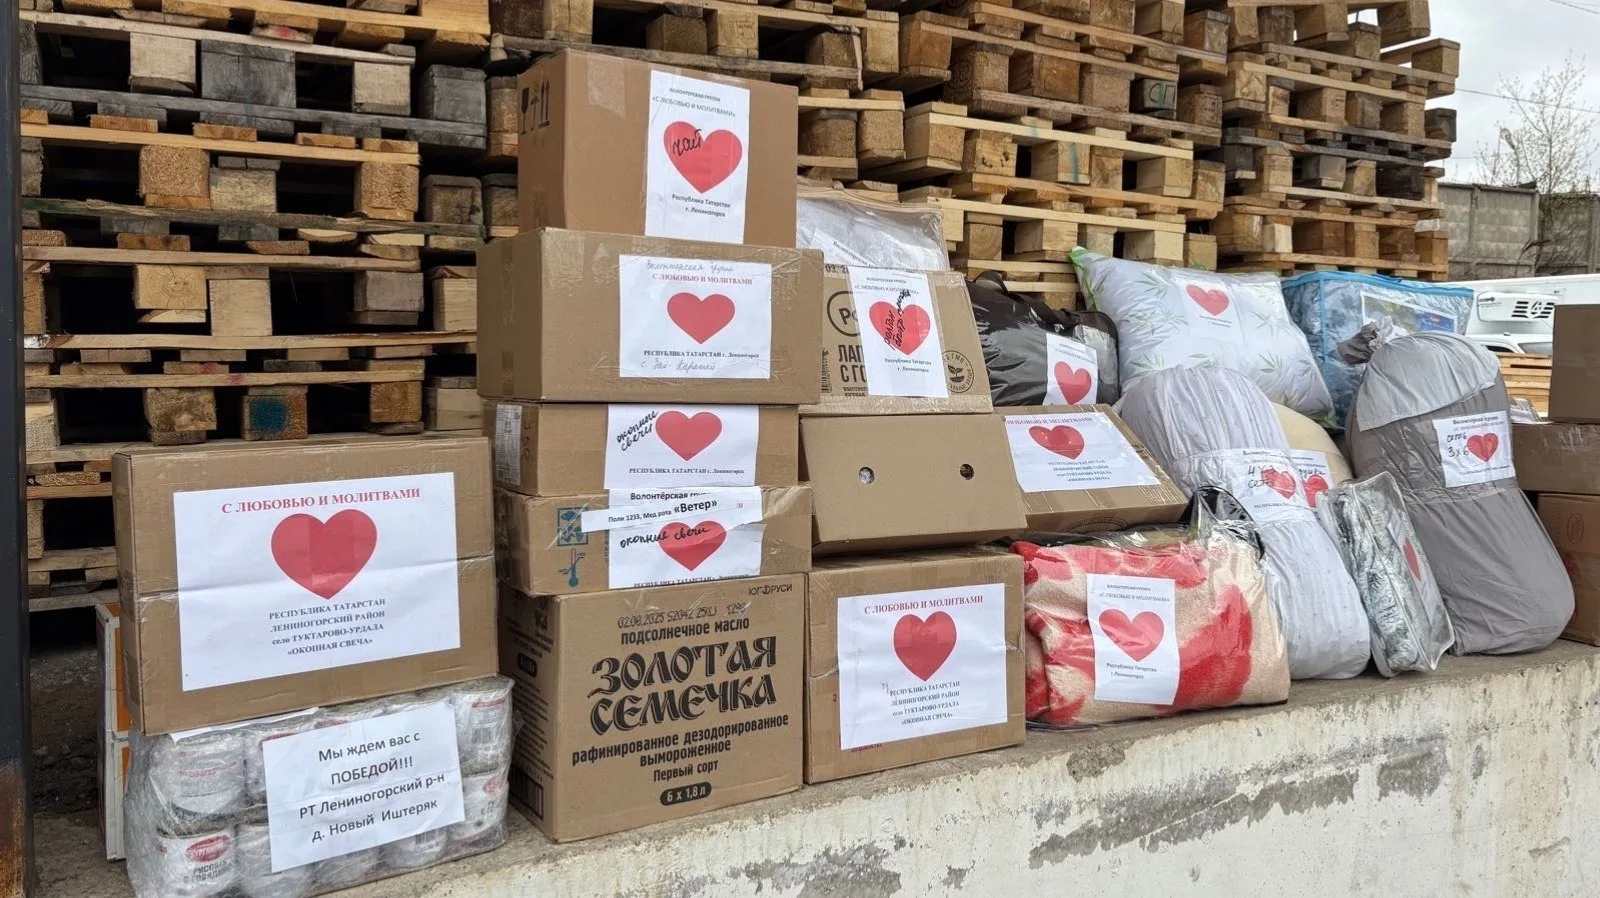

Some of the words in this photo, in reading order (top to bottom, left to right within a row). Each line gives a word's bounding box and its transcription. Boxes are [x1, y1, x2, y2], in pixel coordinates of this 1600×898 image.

[672, 194, 704, 204] Республика
[705, 199, 731, 208] Татарстан
[690, 207, 726, 218] Лениногорск
[660, 274, 700, 282] ЛЮБОВЬЮ
[707, 276, 753, 285] МОЛИТВАМИ
[221, 503, 232, 513] С
[235, 496, 315, 513] ЛЮБОВЬЮ
[318, 495, 328, 505] И
[331, 488, 421, 505] МОЛИТВАМИ
[630, 491, 688, 500] Волонтёрская
[626, 513, 642, 521] 1233,
[643, 511, 658, 519] Мед
[658, 510, 672, 518] рота
[674, 499, 718, 513] «Ветер»
[269, 605, 331, 620] РЕСПУБЛИКА
[332, 598, 386, 611] ТАТАРСТАН
[864, 606, 871, 615] С
[872, 602, 919, 613] ЛЮБОВЬЮ
[929, 595, 983, 608] МОЛИТВАМИ
[270, 614, 353, 632] ЛЕНИНОГОРСКИЙ
[354, 610, 385, 621] РАЙОН
[621, 622, 710, 645] подсолнечное
[714, 617, 750, 633] масло
[272, 637, 290, 645] село
[292, 623, 384, 643] ТУКТАРОВО-УРДАЛА
[287, 641, 338, 656] «ОКОПНАЯ
[339, 637, 373, 648] СВЕЧА»
[587, 636, 777, 698] ЗОЛОТАЯ
[889, 686, 927, 697] РЕСПУБЛИКА
[928, 680, 960, 690] ТАТАРСТАН
[890, 694, 940, 706] ЛЕНИНОГОРСКИЙ
[941, 690, 960, 699] РАЙОН
[590, 673, 777, 735] СЕМЕЧКА
[904, 701, 960, 714] ТУКТАРОВО-УРДАЛА
[318, 748, 343, 762] Мы
[346, 740, 386, 756] ждем
[389, 734, 411, 747] вас
[413, 732, 421, 742] с
[572, 733, 679, 766] рафинированное
[683, 714, 789, 746] дезодорированное
[640, 739, 732, 767] вымороженное
[331, 755, 413, 785] ПОБЕДОЙ!!!
[653, 763, 694, 783] Первый
[697, 759, 719, 774] сорт
[299, 804, 316, 819] РТ
[319, 778, 423, 814] Лениногорский
[425, 773, 445, 789] р-н
[667, 791, 673, 802] 6
[685, 787, 698, 800] 1,8
[312, 830, 325, 843] д.
[329, 814, 375, 836] Новый
[381, 798, 438, 822] Иштеряк
